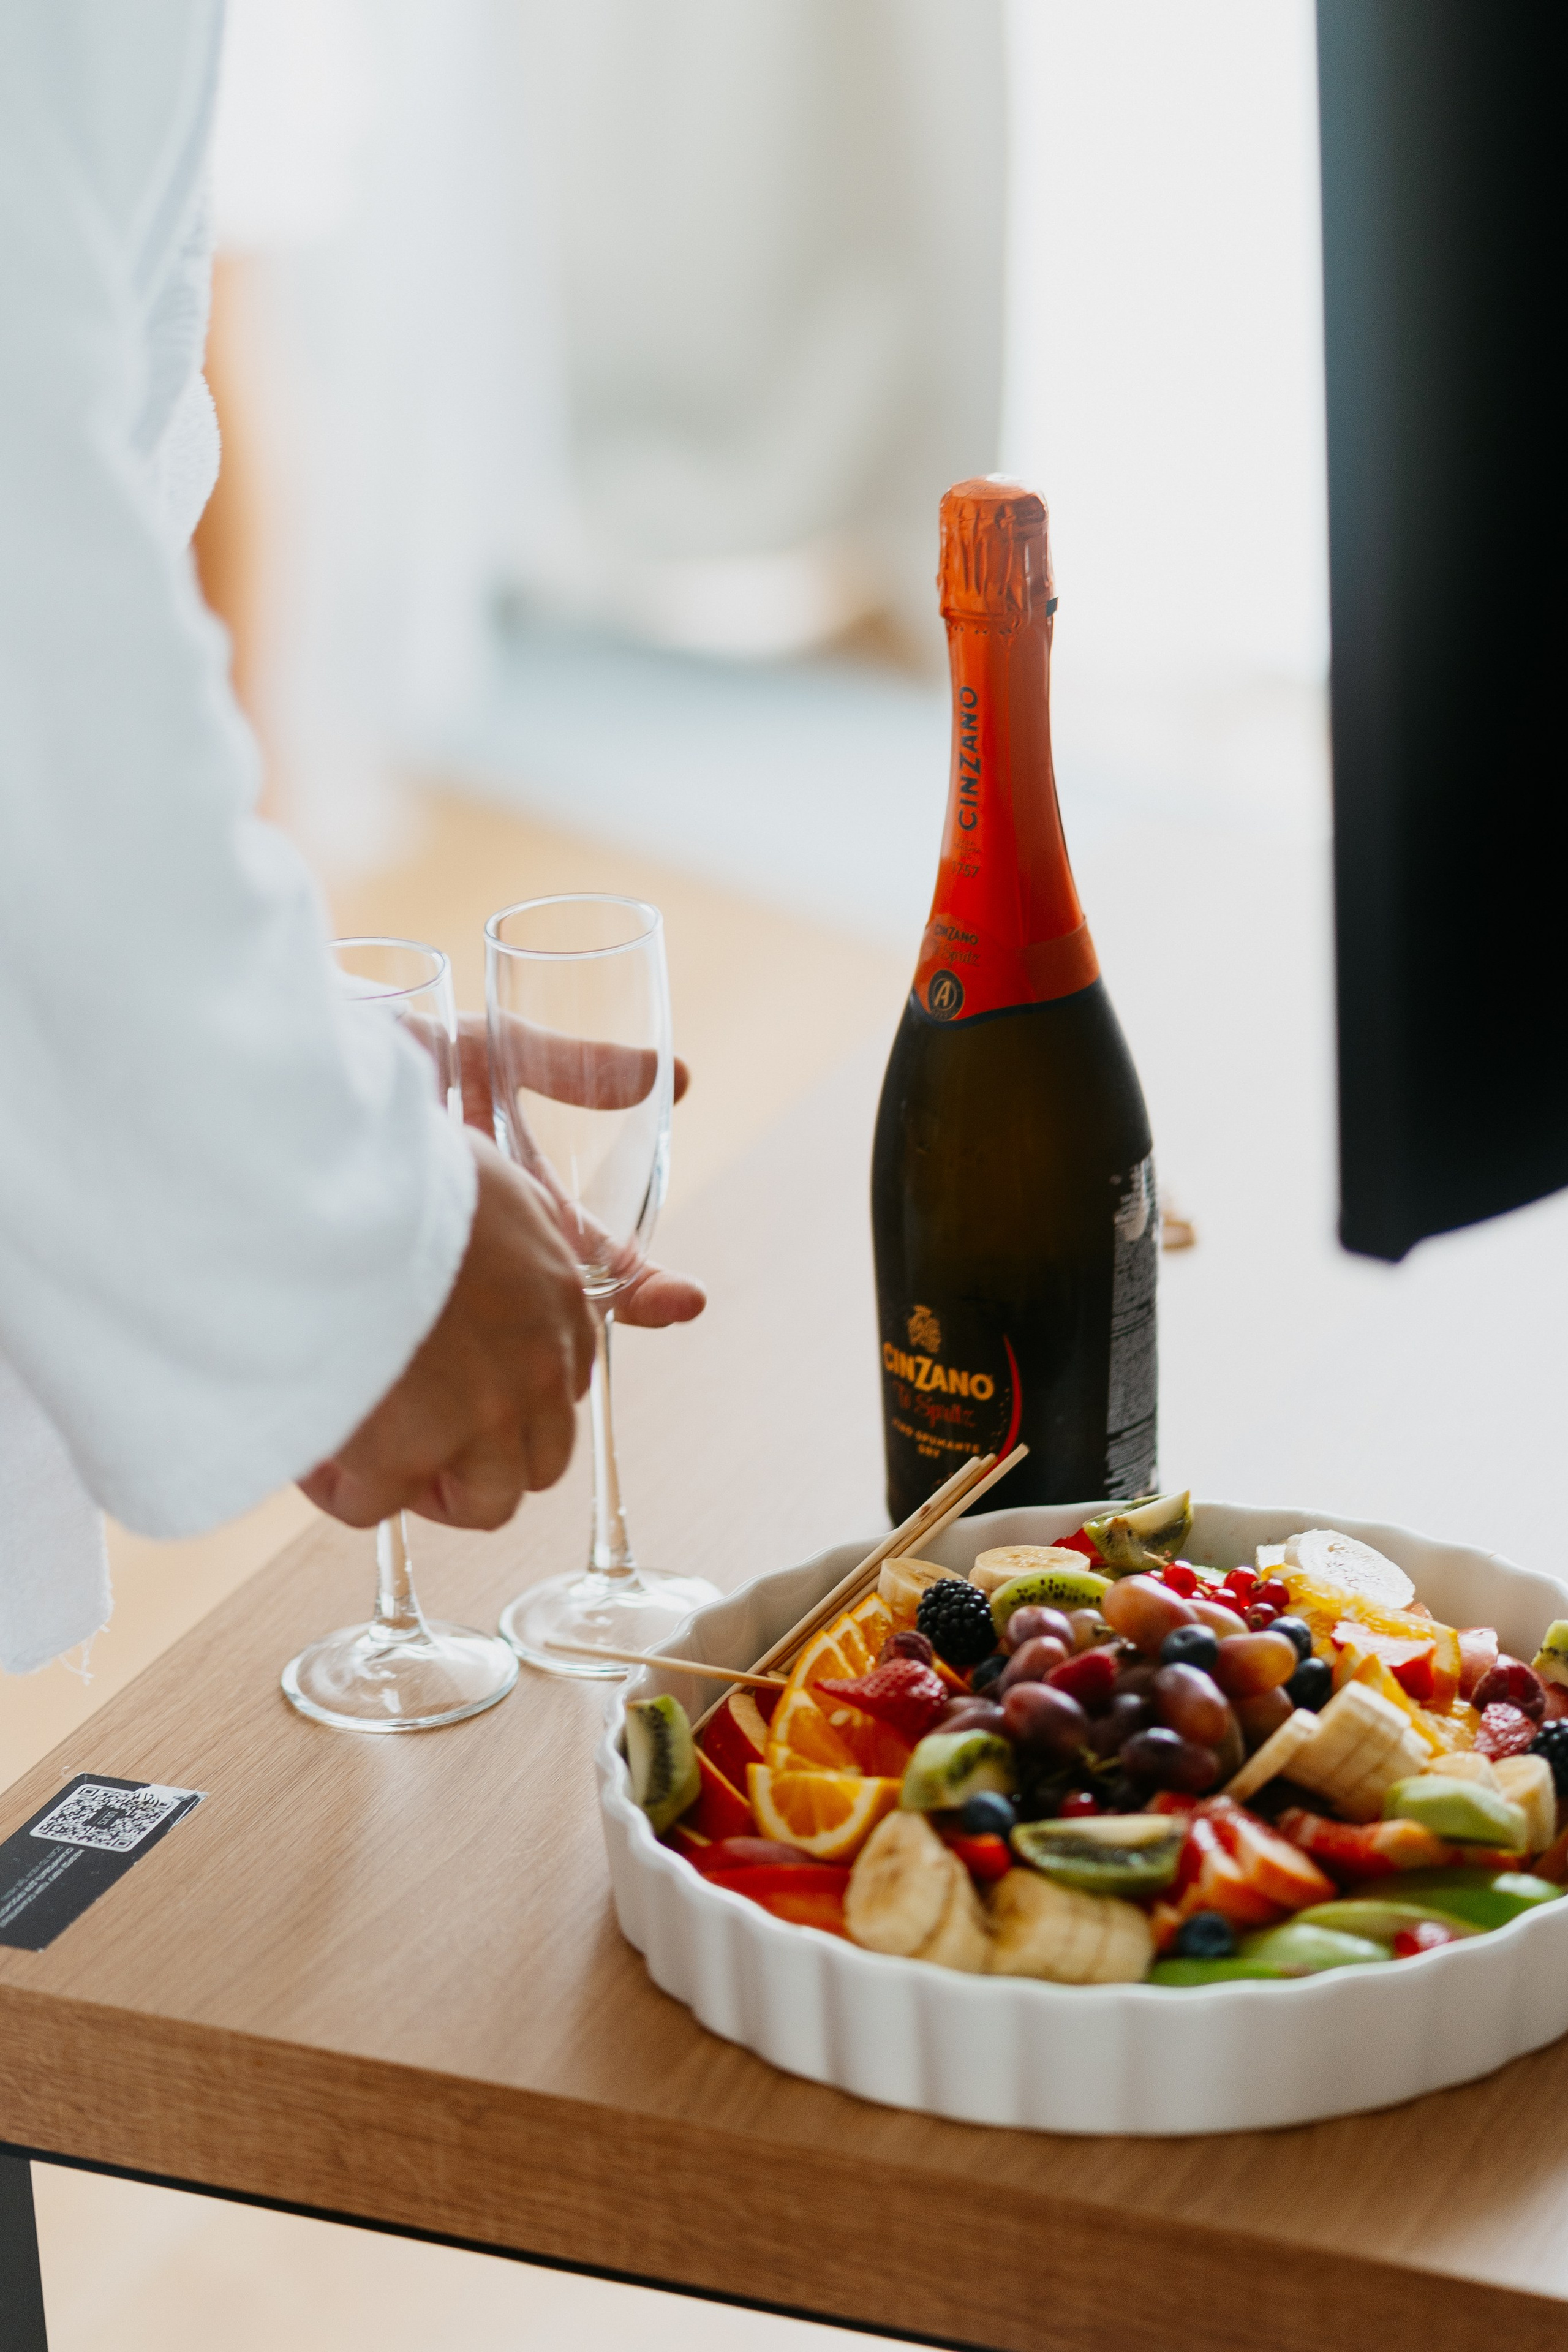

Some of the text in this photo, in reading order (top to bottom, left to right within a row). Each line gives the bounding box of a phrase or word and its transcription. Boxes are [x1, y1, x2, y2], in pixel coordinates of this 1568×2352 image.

[959, 686, 981, 831] CINZANO
[952, 860, 980, 878] 1757
[933, 924, 979, 946] CINZANO
[933, 979, 952, 1007] A
[882, 1341, 995, 1402] CINZANO
